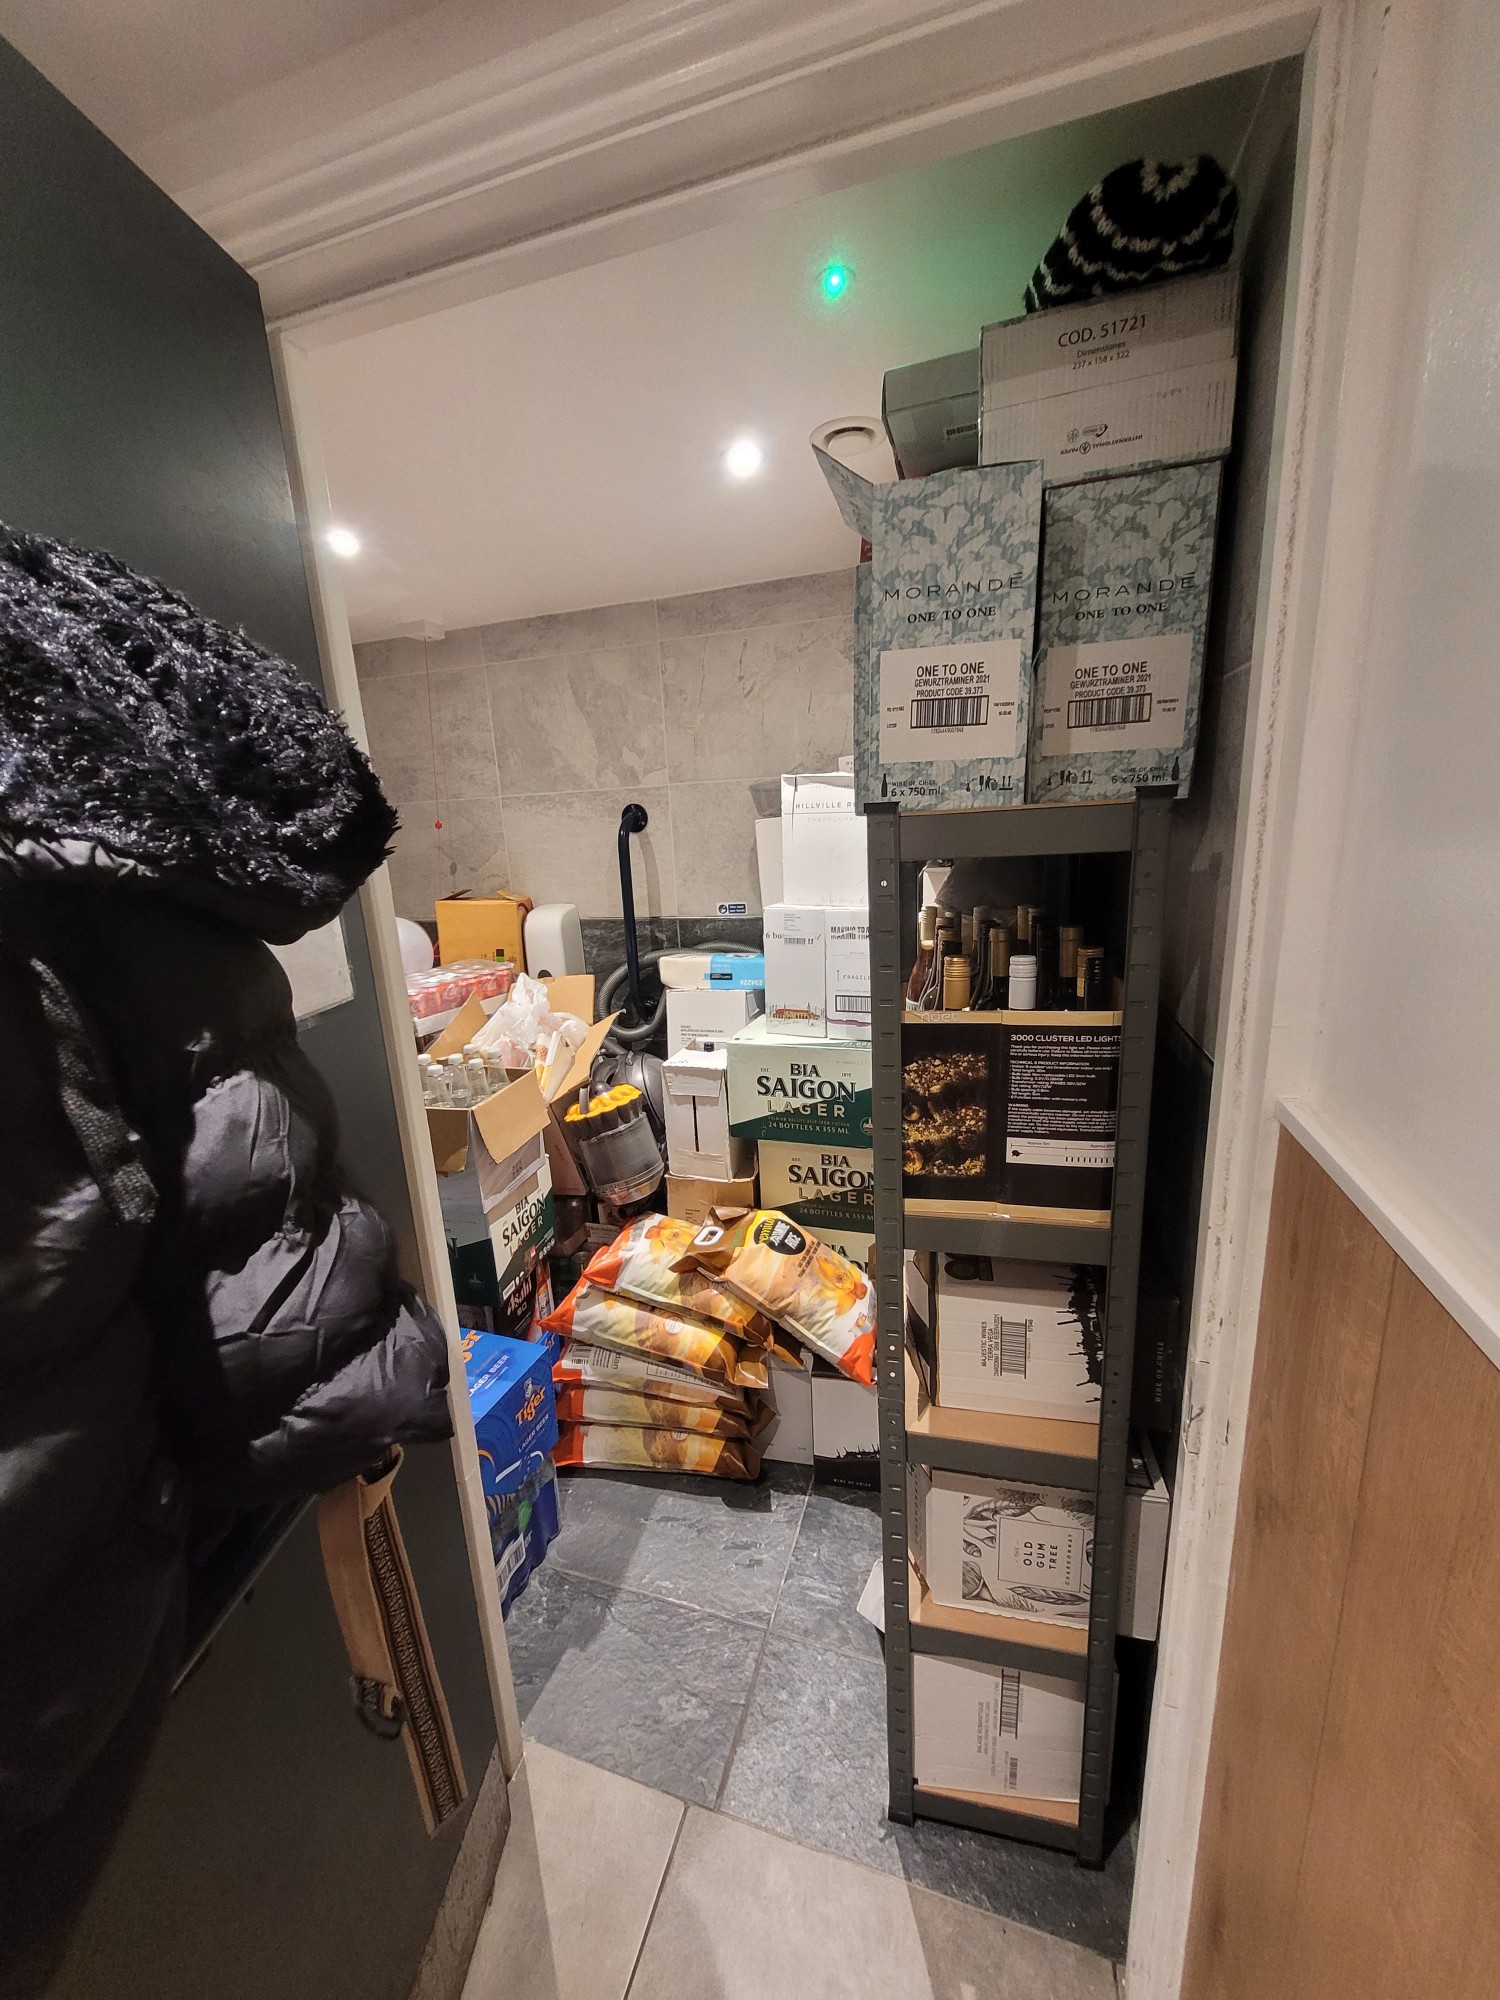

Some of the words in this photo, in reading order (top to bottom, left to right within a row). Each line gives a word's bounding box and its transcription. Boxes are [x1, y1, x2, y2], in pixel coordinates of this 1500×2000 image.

[1058, 328, 1096, 347] COD.
[1101, 314, 1146, 338] 51721
[1078, 341, 1126, 358] Dimensiones
[1073, 360, 1086, 370] 237
[1116, 350, 1130, 359] 322
[884, 572, 1024, 601] MORANDÉ
[1052, 572, 1196, 604] MORANDÉ
[907, 612, 936, 624] ONE
[942, 609, 962, 621] TO
[966, 606, 997, 618] ONE
[1075, 609, 1105, 622] ONE
[1112, 606, 1132, 617] TO
[1136, 602, 1168, 614] ONE
[917, 665, 939, 678] ONE
[942, 664, 957, 676] TO
[960, 661, 985, 674] ONE
[1075, 666, 1099, 679] ONE
[1102, 664, 1118, 677] TO
[1122, 661, 1148, 675] ONE
[915, 676, 974, 688] GEWURZTRAMINER
[976, 674, 990, 684] 2021
[1070, 676, 1135, 689] GEWURZTRAMINER
[1137, 673, 1151, 683] 2021
[916, 688, 944, 698] PRODUCT
[946, 687, 964, 696] CODE
[964, 686, 984, 695] 39.373
[1075, 688, 1104, 699] PRODUCT
[1106, 687, 1125, 696] CODE
[1127, 685, 1147, 694] 39.373
[1111, 775, 1118, 784] 6
[1130, 773, 1148, 783] 750
[1151, 772, 1168, 782] ml.
[891, 788, 897, 797] 6
[908, 787, 925, 796] 750
[929, 786, 943, 796] ml.
[796, 802, 842, 810] HILLVILLE
[831, 927, 856, 940] MAKING
[790, 1063, 821, 1078] BIA
[756, 1075, 856, 1103] SAIGON
[767, 1100, 845, 1118] LAGER
[779, 1123, 813, 1131] BOTTLES
[821, 1154, 852, 1168] BIA
[515, 1196, 530, 1214] BIA
[799, 1187, 874, 1206] LAGER
[502, 1192, 546, 1248] SAIGON
[810, 1208, 843, 1217] BOTTLES
[508, 1218, 544, 1257] LAGER
[770, 1221, 790, 1246] JASMINE
[784, 1232, 802, 1250] RICE
[507, 1276, 533, 1317] Asahi
[489, 1355, 510, 1373] BEER
[515, 1386, 545, 1426] Tiger
[518, 1431, 536, 1454] LAGER
[536, 1414, 549, 1432] BEER
[1023, 1541, 1033, 1566] OLD
[1037, 1543, 1045, 1568] GUM
[1049, 1544, 1058, 1570] TREE
[1065, 1534, 1073, 1585] CHARDONNAY
